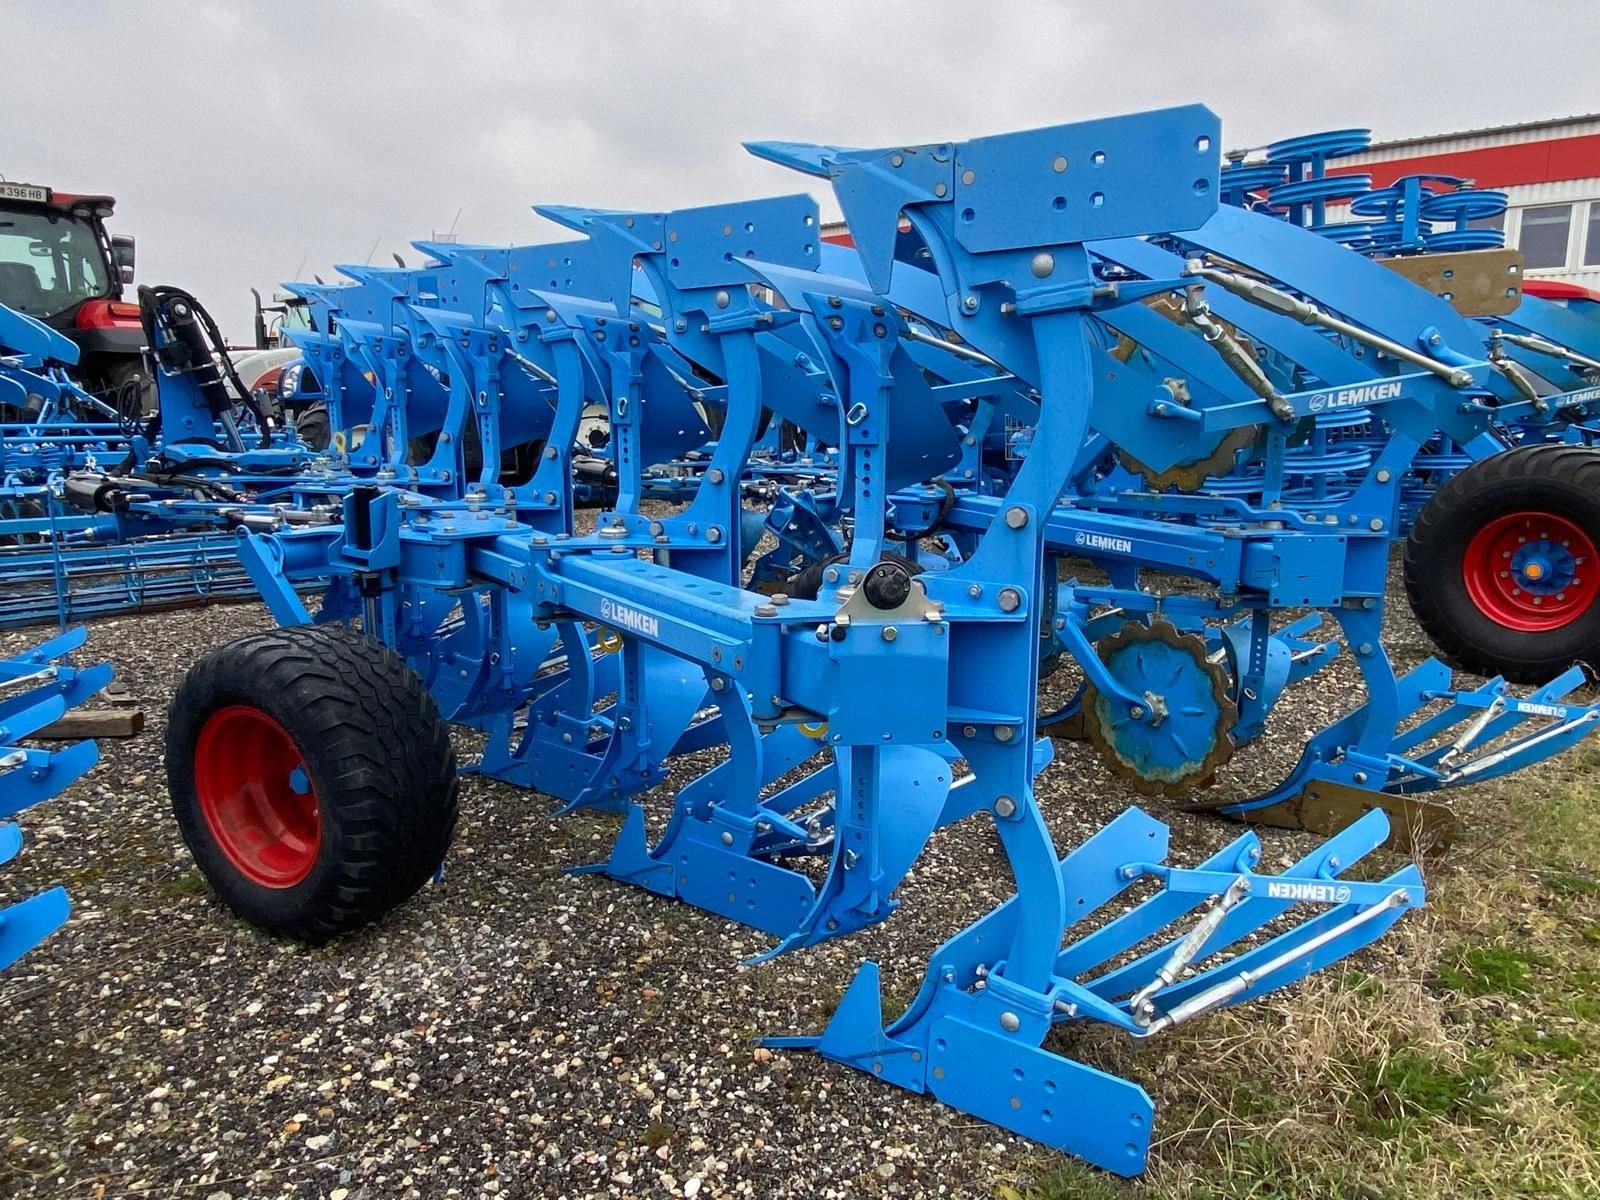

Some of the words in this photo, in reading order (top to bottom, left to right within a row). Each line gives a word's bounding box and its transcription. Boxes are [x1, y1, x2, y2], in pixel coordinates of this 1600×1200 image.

[6, 187, 27, 198] 396
[1327, 382, 1402, 408] LEMKEN
[1086, 534, 1132, 553] LEMKEN
[611, 602, 659, 638] LEMKEN
[1517, 701, 1558, 716] LEMKEN
[1268, 882, 1336, 901] LEMKEN
